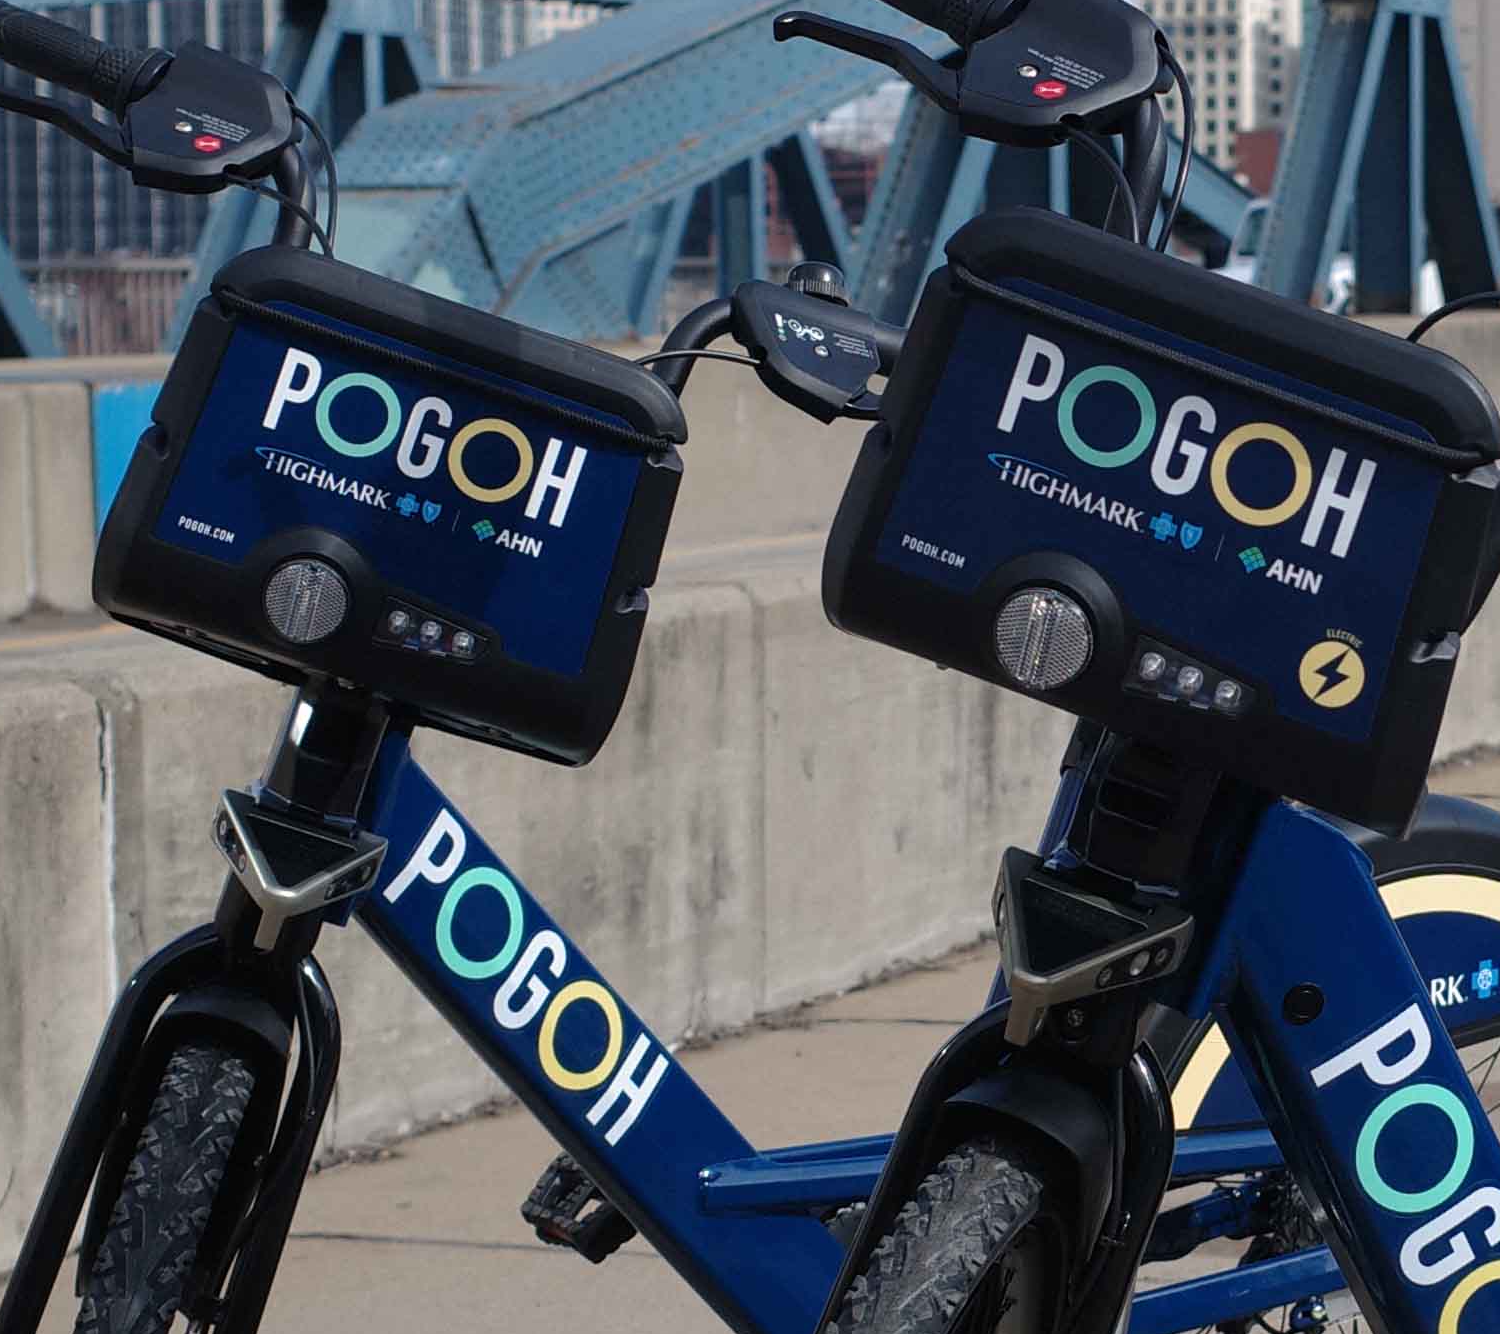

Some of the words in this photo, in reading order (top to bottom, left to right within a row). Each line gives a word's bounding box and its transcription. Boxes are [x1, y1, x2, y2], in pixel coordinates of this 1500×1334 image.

[263, 348, 587, 527] POGOH
[998, 334, 1376, 558] POGOH
[265, 452, 390, 509] HIGHMARK
[1000, 458, 1144, 532] HIGHMARK
[177, 515, 235, 544] POGOH.COM
[495, 528, 543, 558] AHN
[901, 534, 966, 569] POGOH.COM
[1265, 558, 1323, 595] AHN
[383, 808, 669, 1147] POGOH
